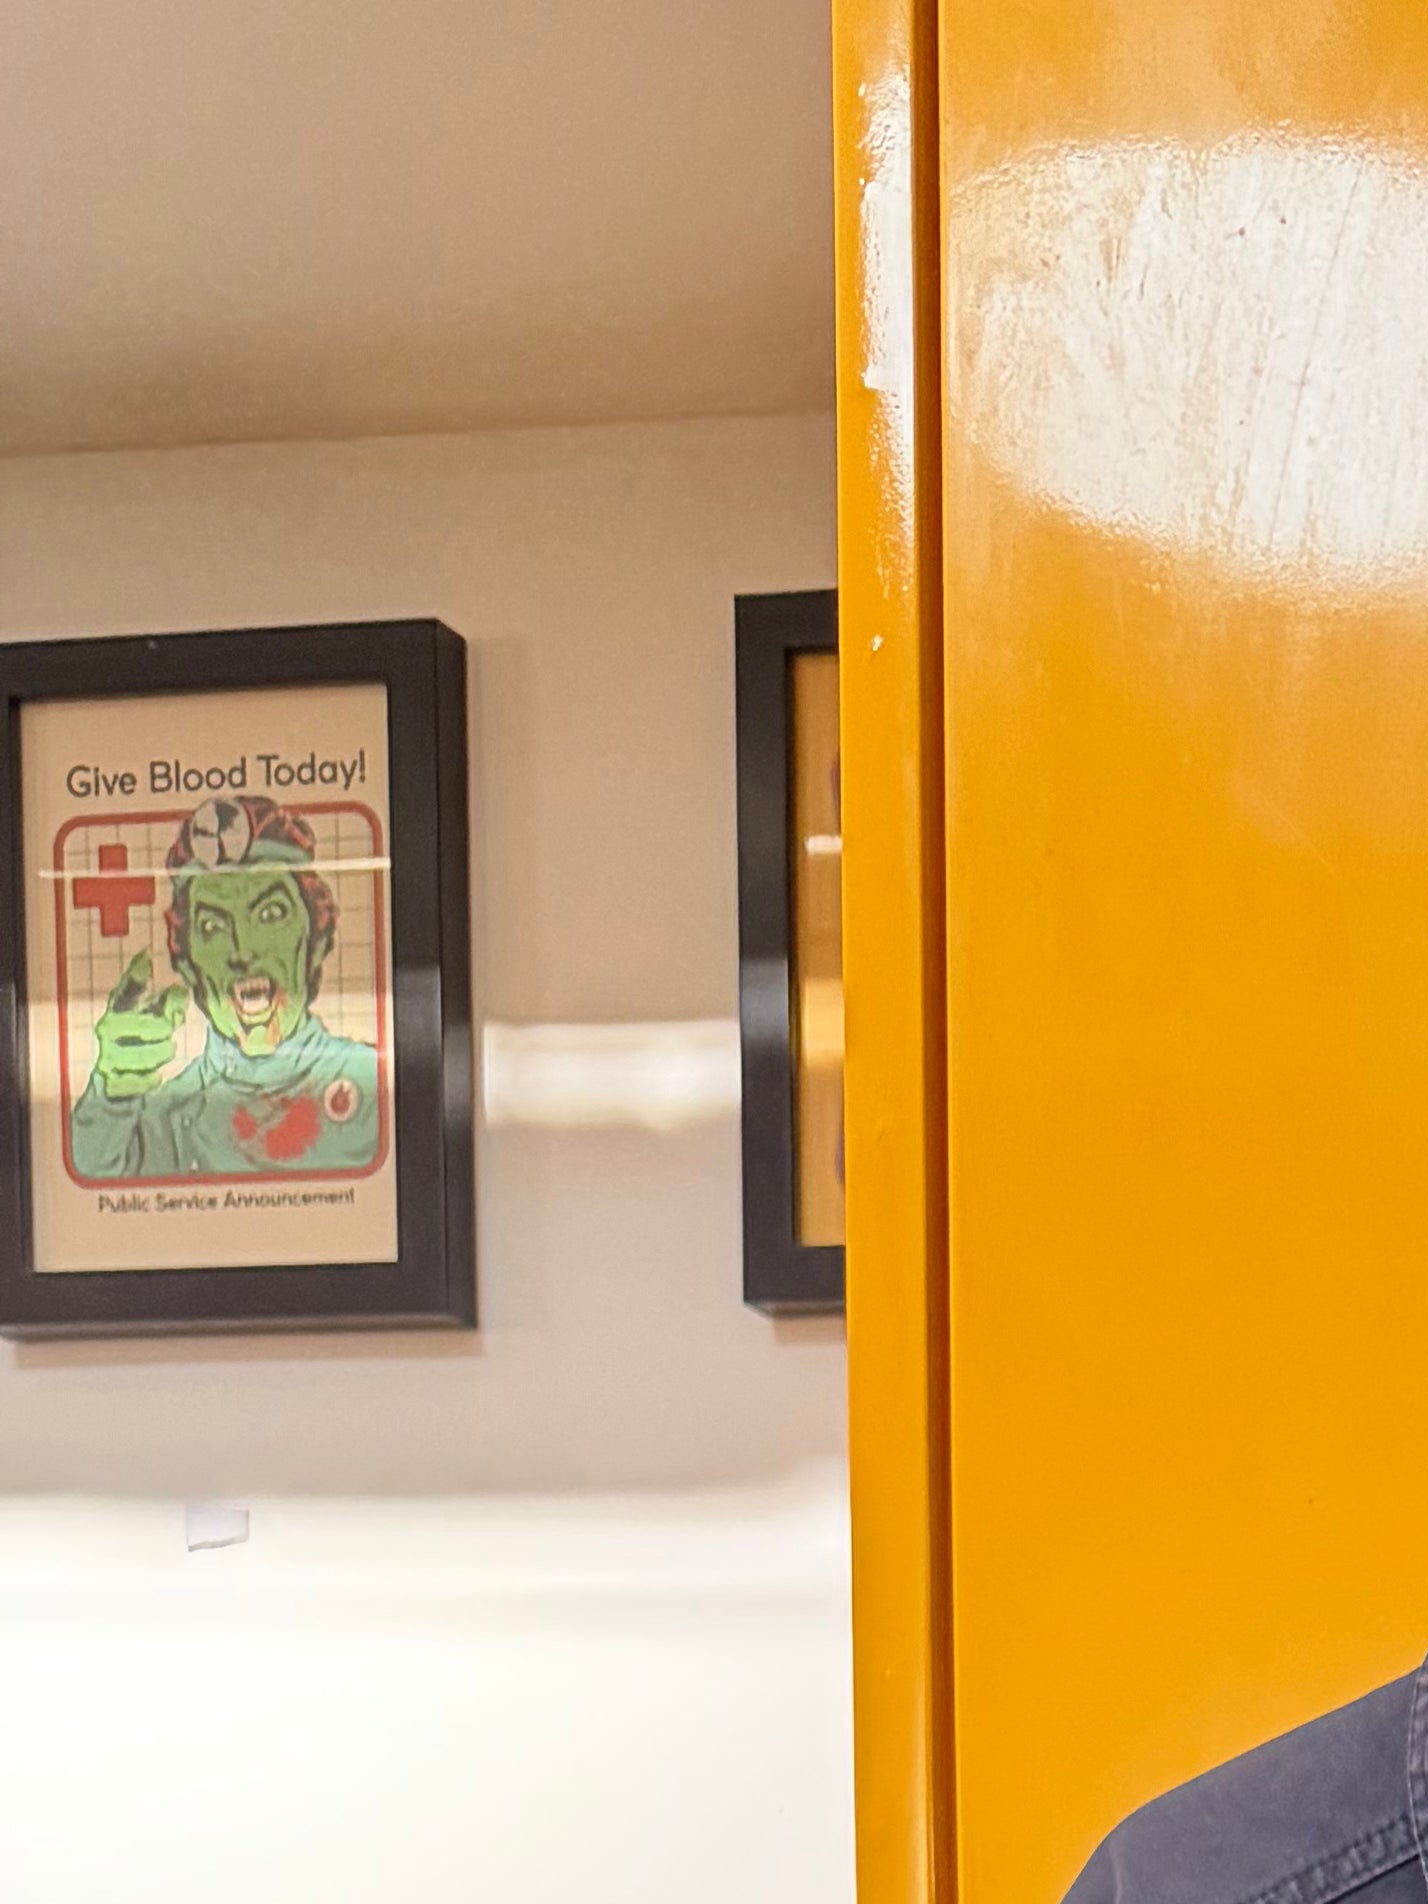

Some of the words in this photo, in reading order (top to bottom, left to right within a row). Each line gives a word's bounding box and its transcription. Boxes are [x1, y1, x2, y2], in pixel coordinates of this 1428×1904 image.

[66, 764, 137, 798] Give
[149, 756, 247, 793] Blood
[256, 747, 366, 791] Today!
[98, 1193, 149, 1213] Public
[155, 1191, 218, 1212] Service
[223, 1187, 355, 1209] Announcement
